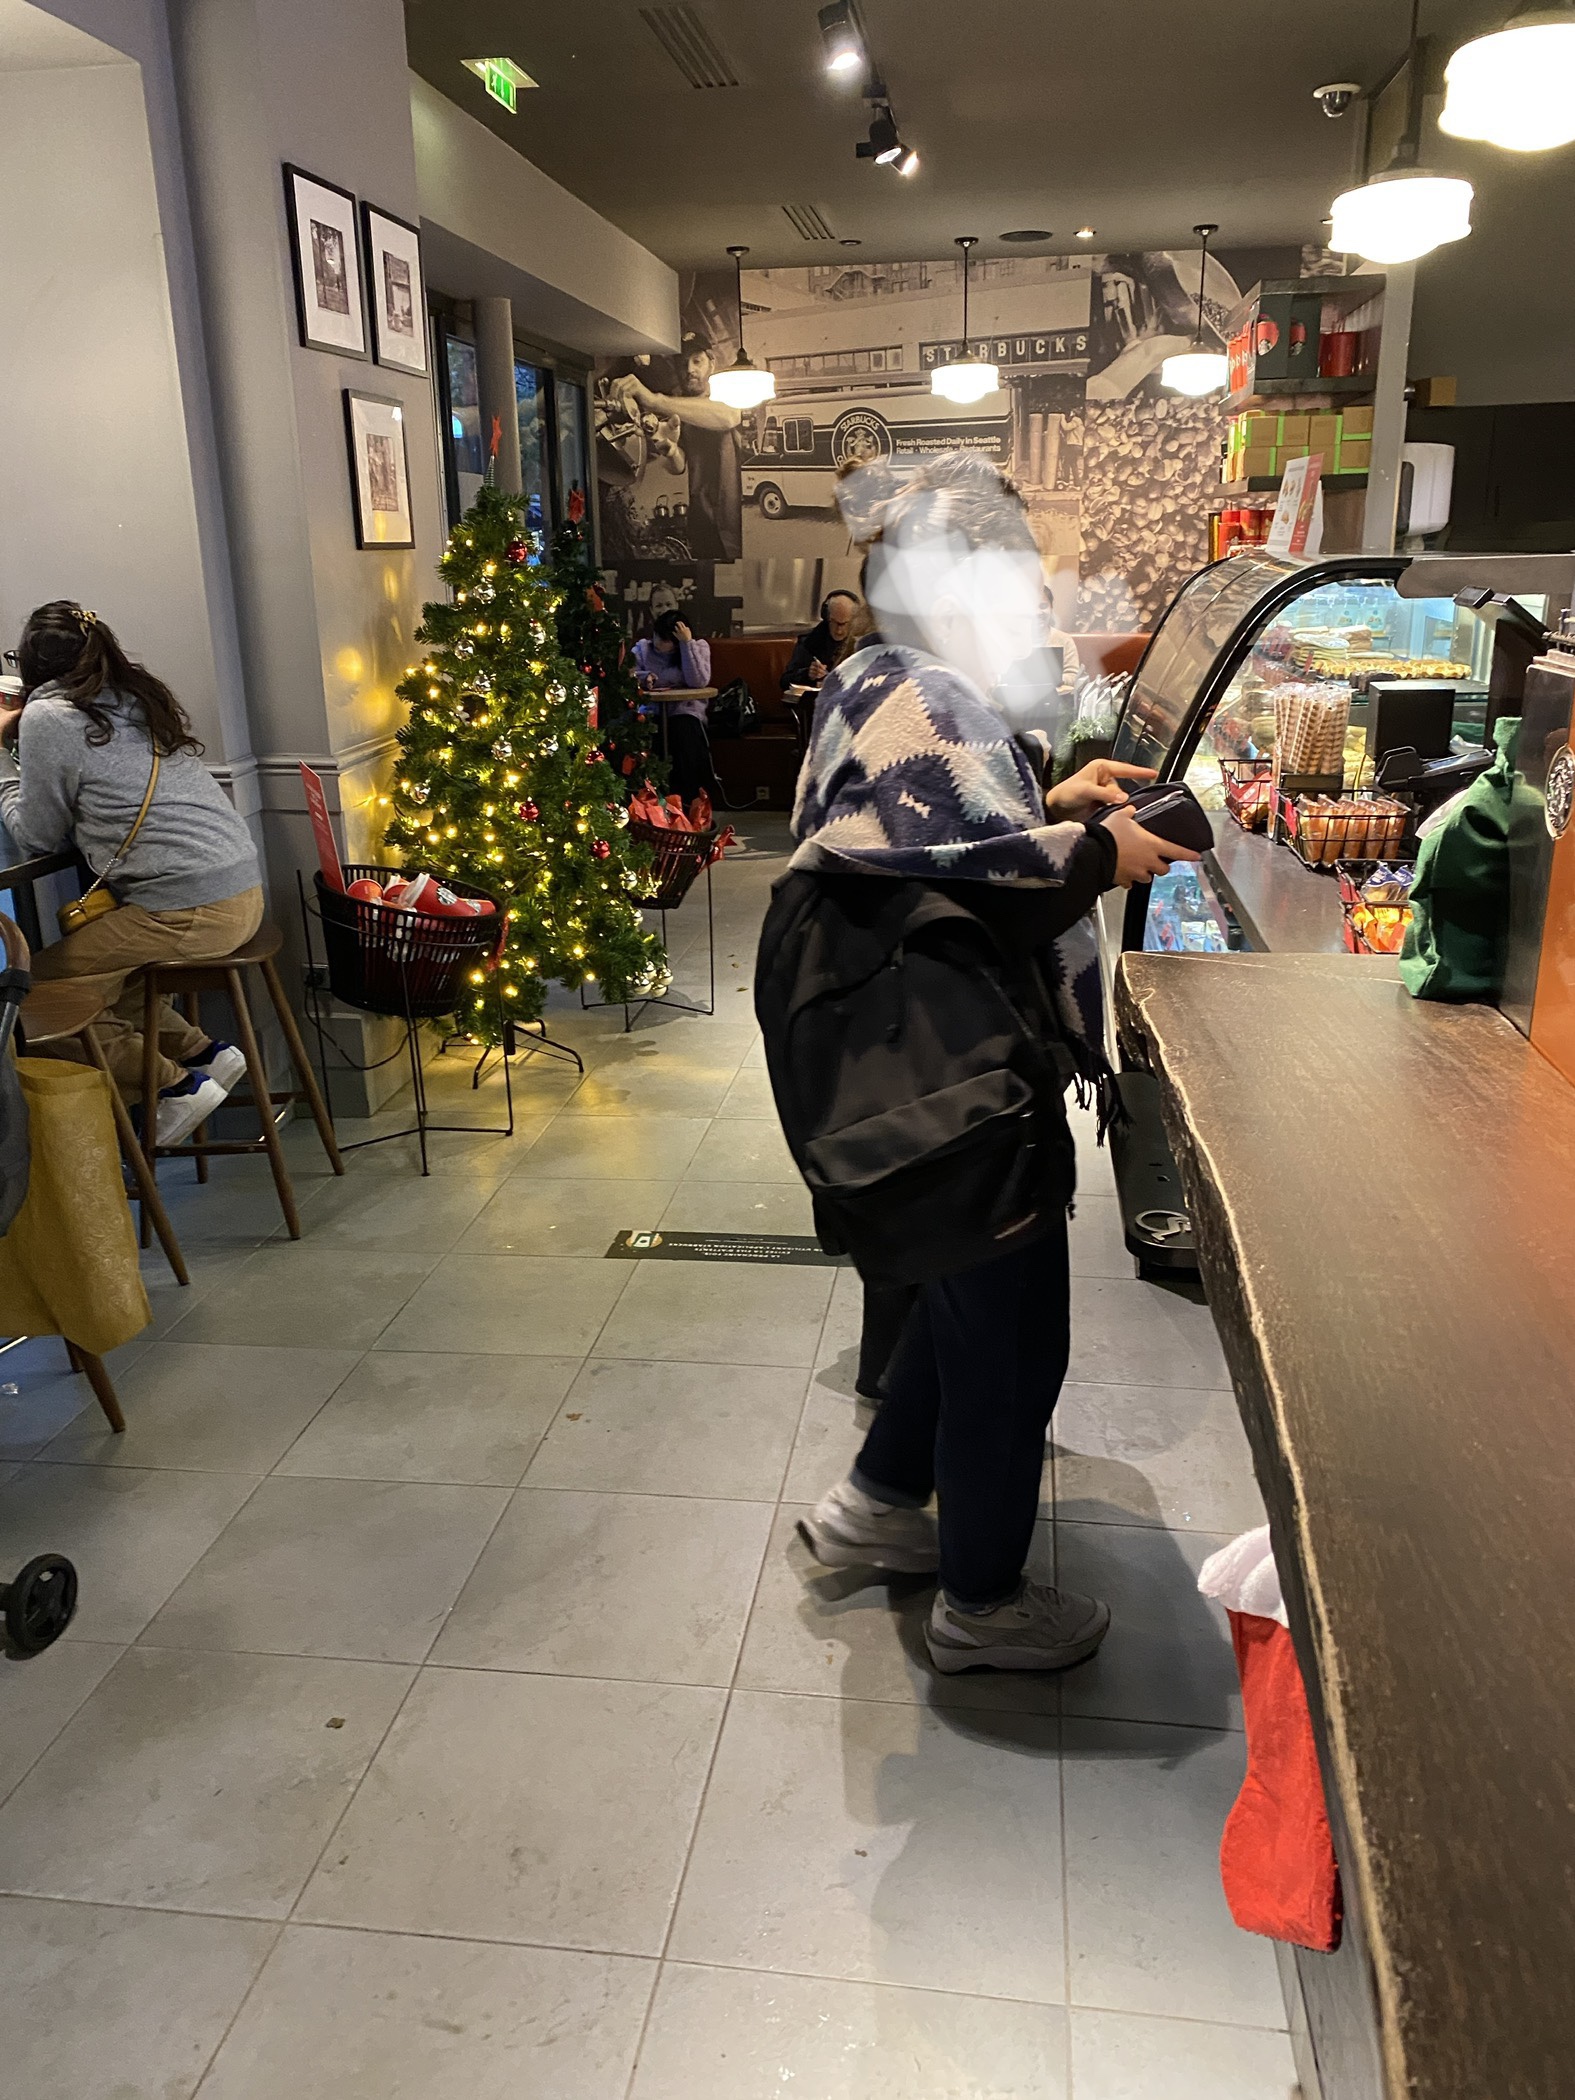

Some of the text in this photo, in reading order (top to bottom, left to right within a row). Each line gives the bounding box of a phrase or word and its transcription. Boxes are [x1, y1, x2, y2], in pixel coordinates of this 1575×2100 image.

[926, 335, 1087, 363] STRBUCKS
[840, 415, 880, 432] STARBUCKS
[896, 435, 1002, 447] Fresh Roasted Daily in Seattle
[896, 446, 914, 454] Retail
